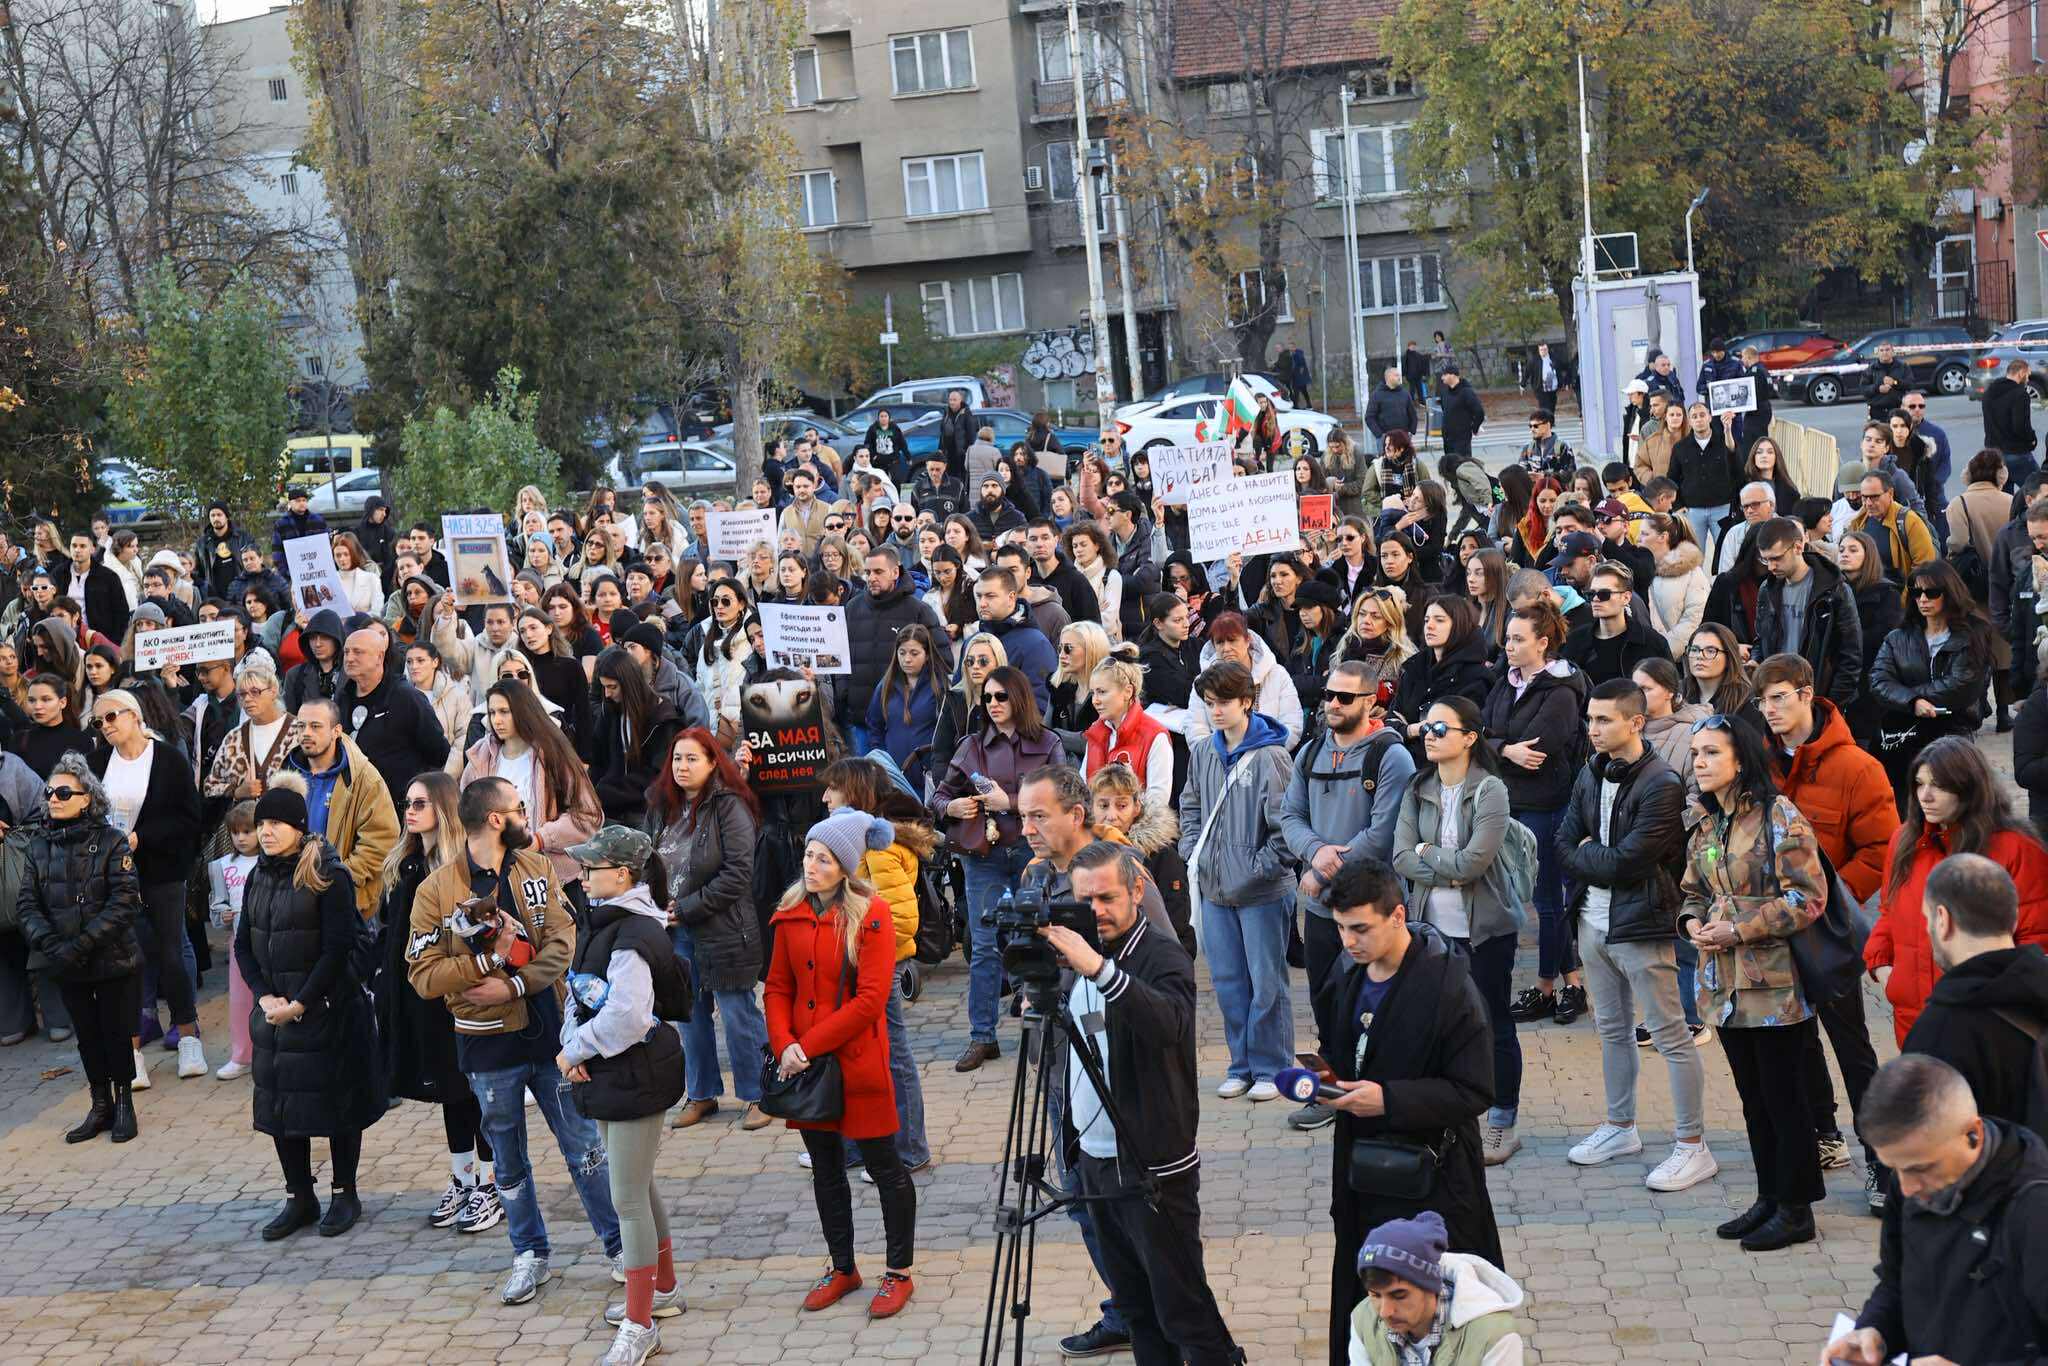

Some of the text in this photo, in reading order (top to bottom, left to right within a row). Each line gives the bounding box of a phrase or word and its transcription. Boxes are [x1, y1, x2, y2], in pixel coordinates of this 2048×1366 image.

[1158, 446, 1227, 468] АПАТИЯТА
[1155, 463, 1217, 495] УБИВА!
[1189, 475, 1289, 501] ДНЕС СА НАШИТЕ
[1189, 493, 1296, 520] ДОМАШНИ ЛЮБИМЦИ
[1190, 522, 1217, 536] УТРЕ
[1254, 514, 1267, 524] СА
[1192, 527, 1292, 552] НАШИТЕ ДЕЦА
[781, 612, 820, 621] Ефективни
[143, 637, 159, 648] АКО
[749, 726, 819, 749] ЗА МАЯ
[768, 749, 826, 764] ВСИЧКИ
[759, 767, 814, 781] след нея
[522, 878, 548, 909] 98
